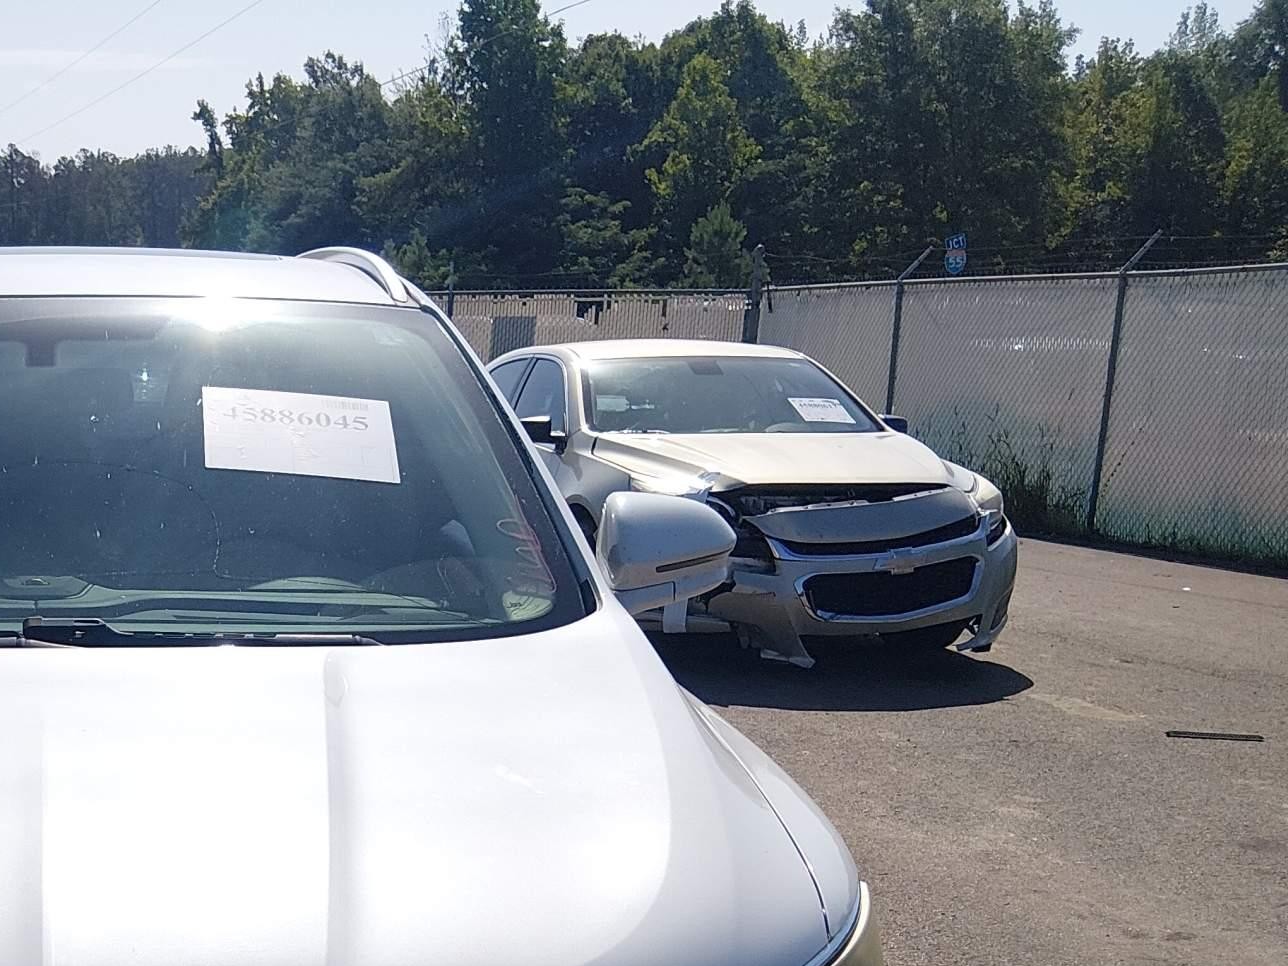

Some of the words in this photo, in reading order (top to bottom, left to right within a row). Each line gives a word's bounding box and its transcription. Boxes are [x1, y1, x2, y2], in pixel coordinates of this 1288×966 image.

[949, 236, 963, 250] JCT
[948, 256, 963, 268] 55
[223, 405, 369, 431] 45886045
